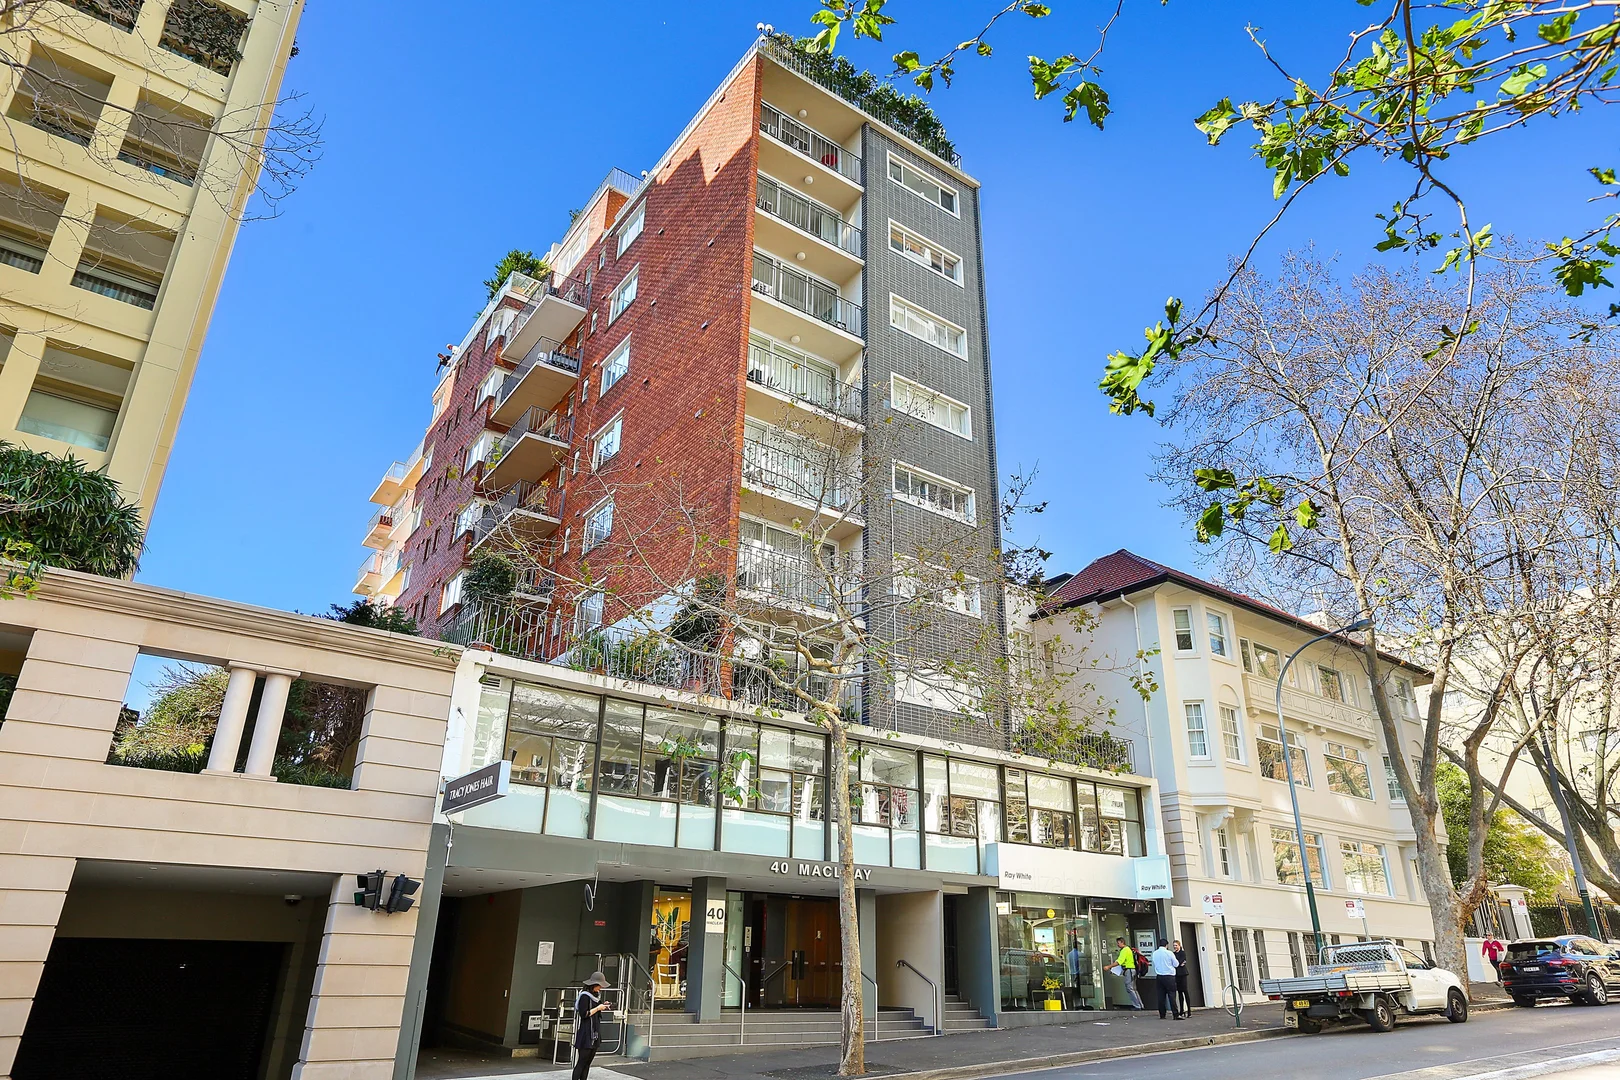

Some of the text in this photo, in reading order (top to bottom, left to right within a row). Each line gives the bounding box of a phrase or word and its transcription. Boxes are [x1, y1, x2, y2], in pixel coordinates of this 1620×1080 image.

[449, 775, 494, 800] TRACY JONES HAIR
[770, 861, 872, 880] 40 MACLAY
[1004, 870, 1032, 880] Ray White
[707, 908, 724, 920] 40
